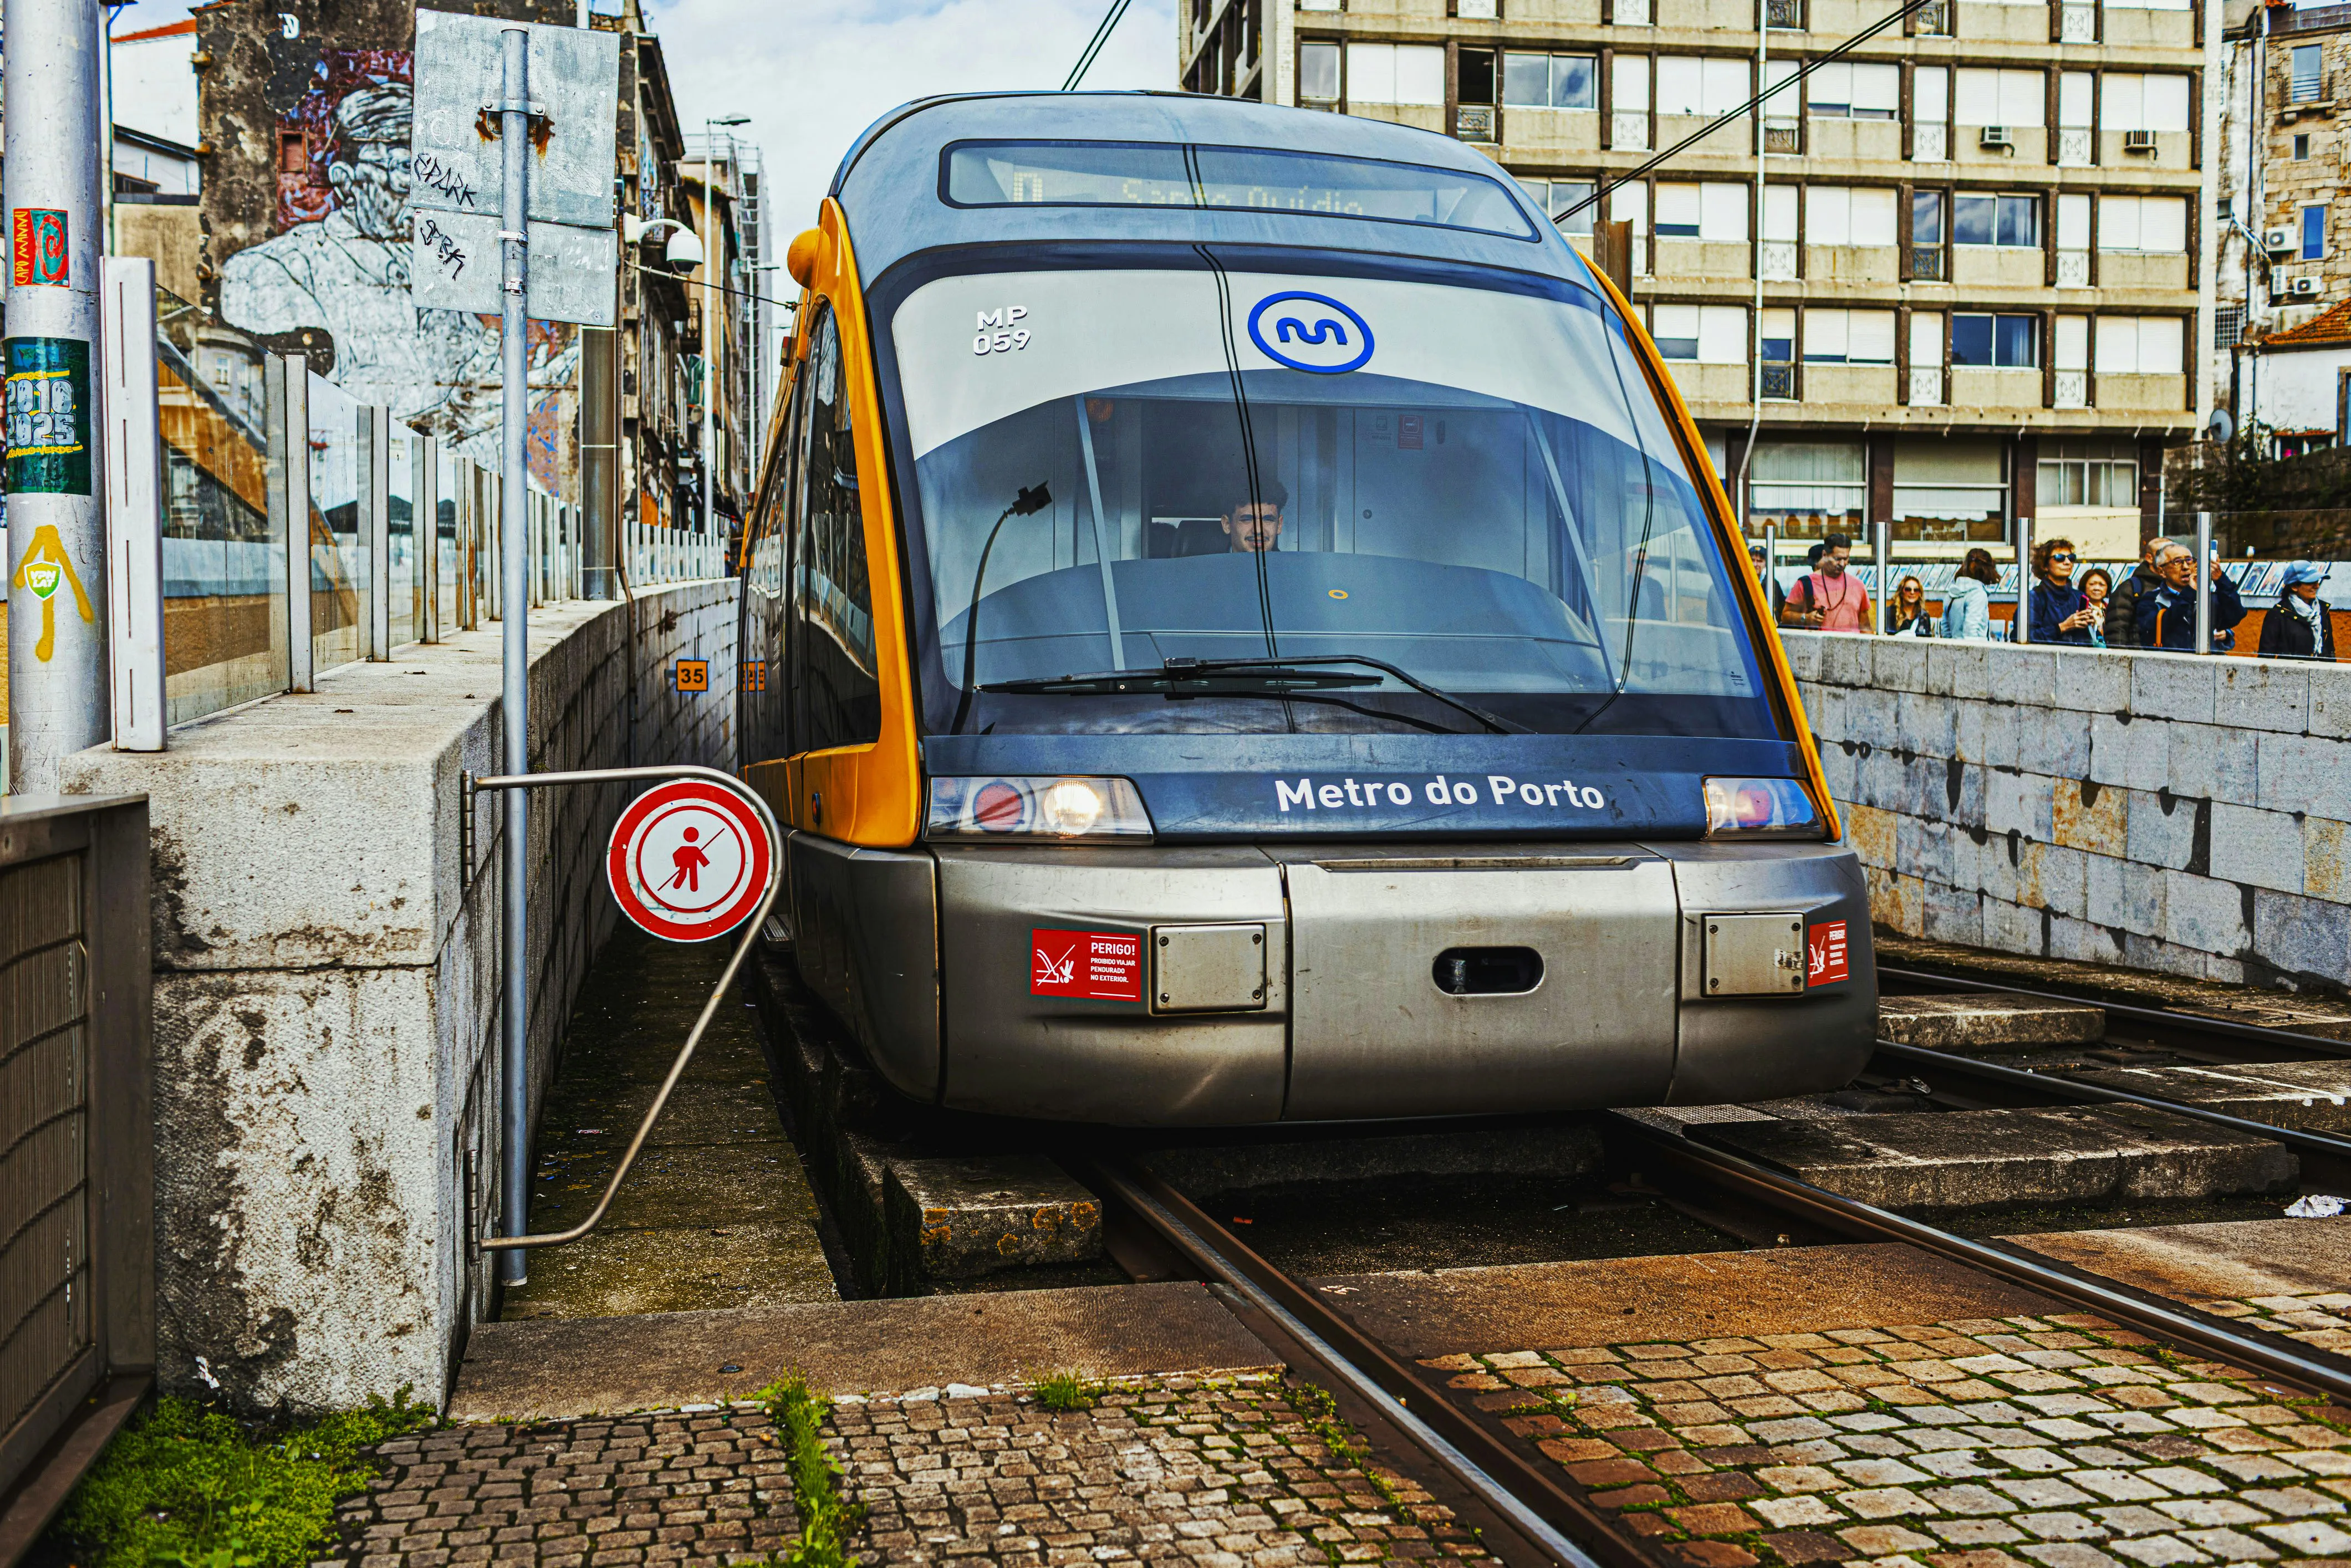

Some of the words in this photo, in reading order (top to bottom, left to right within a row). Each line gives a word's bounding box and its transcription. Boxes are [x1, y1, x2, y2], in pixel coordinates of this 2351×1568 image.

[14, 211, 29, 258] MANNU
[16, 261, 29, 284] CAPO
[977, 305, 1028, 331] MP
[973, 329, 1032, 355] 059
[6, 379, 74, 414] 2010
[6, 412, 76, 447] 2025
[681, 668, 703, 683] 35
[1276, 778, 1412, 811] Metro
[1425, 775, 1478, 805] do
[1488, 775, 1605, 810] Porto
[1091, 942, 1135, 956] PERIGO!
[1090, 966, 1125, 974] PENDURADO
[1099, 974, 1129, 983] EXTERIOR.
